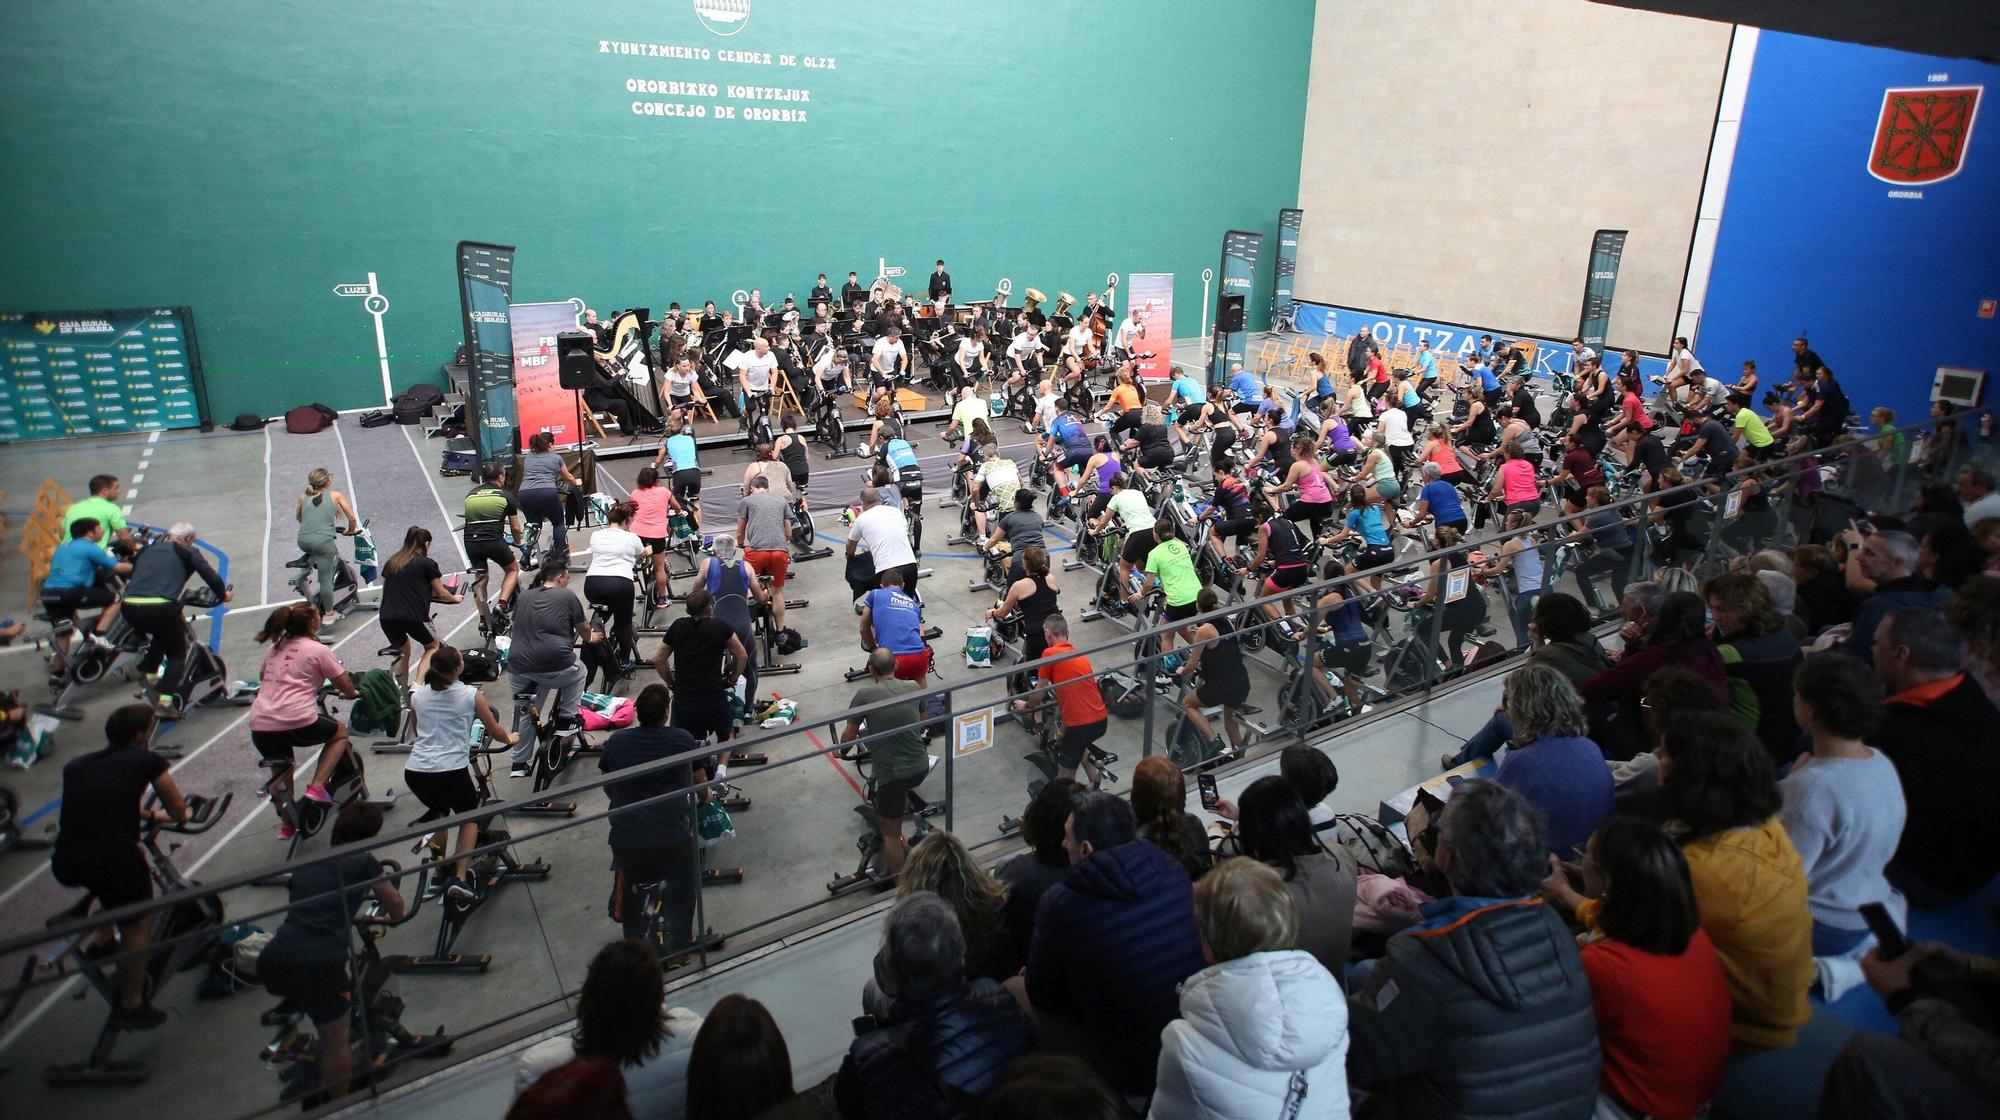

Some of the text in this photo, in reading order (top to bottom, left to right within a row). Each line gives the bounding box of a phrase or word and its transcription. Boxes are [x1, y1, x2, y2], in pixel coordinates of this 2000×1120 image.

[599, 40, 836, 70] AYUNTAMIENTO CENDEA DE OLZA
[626, 78, 810, 103] ORORBIAKO KONTZEJUA
[632, 101, 808, 123] CONCEJO DE ORORBIA
[1887, 190, 1923, 199] ORORBIA
[344, 286, 368, 294] LUZE
[372, 300, 381, 309] 7
[539, 336, 558, 346] FB
[1372, 321, 1476, 358] OLTZA
[521, 356, 549, 367] MBF
[890, 596, 914, 609] muro
